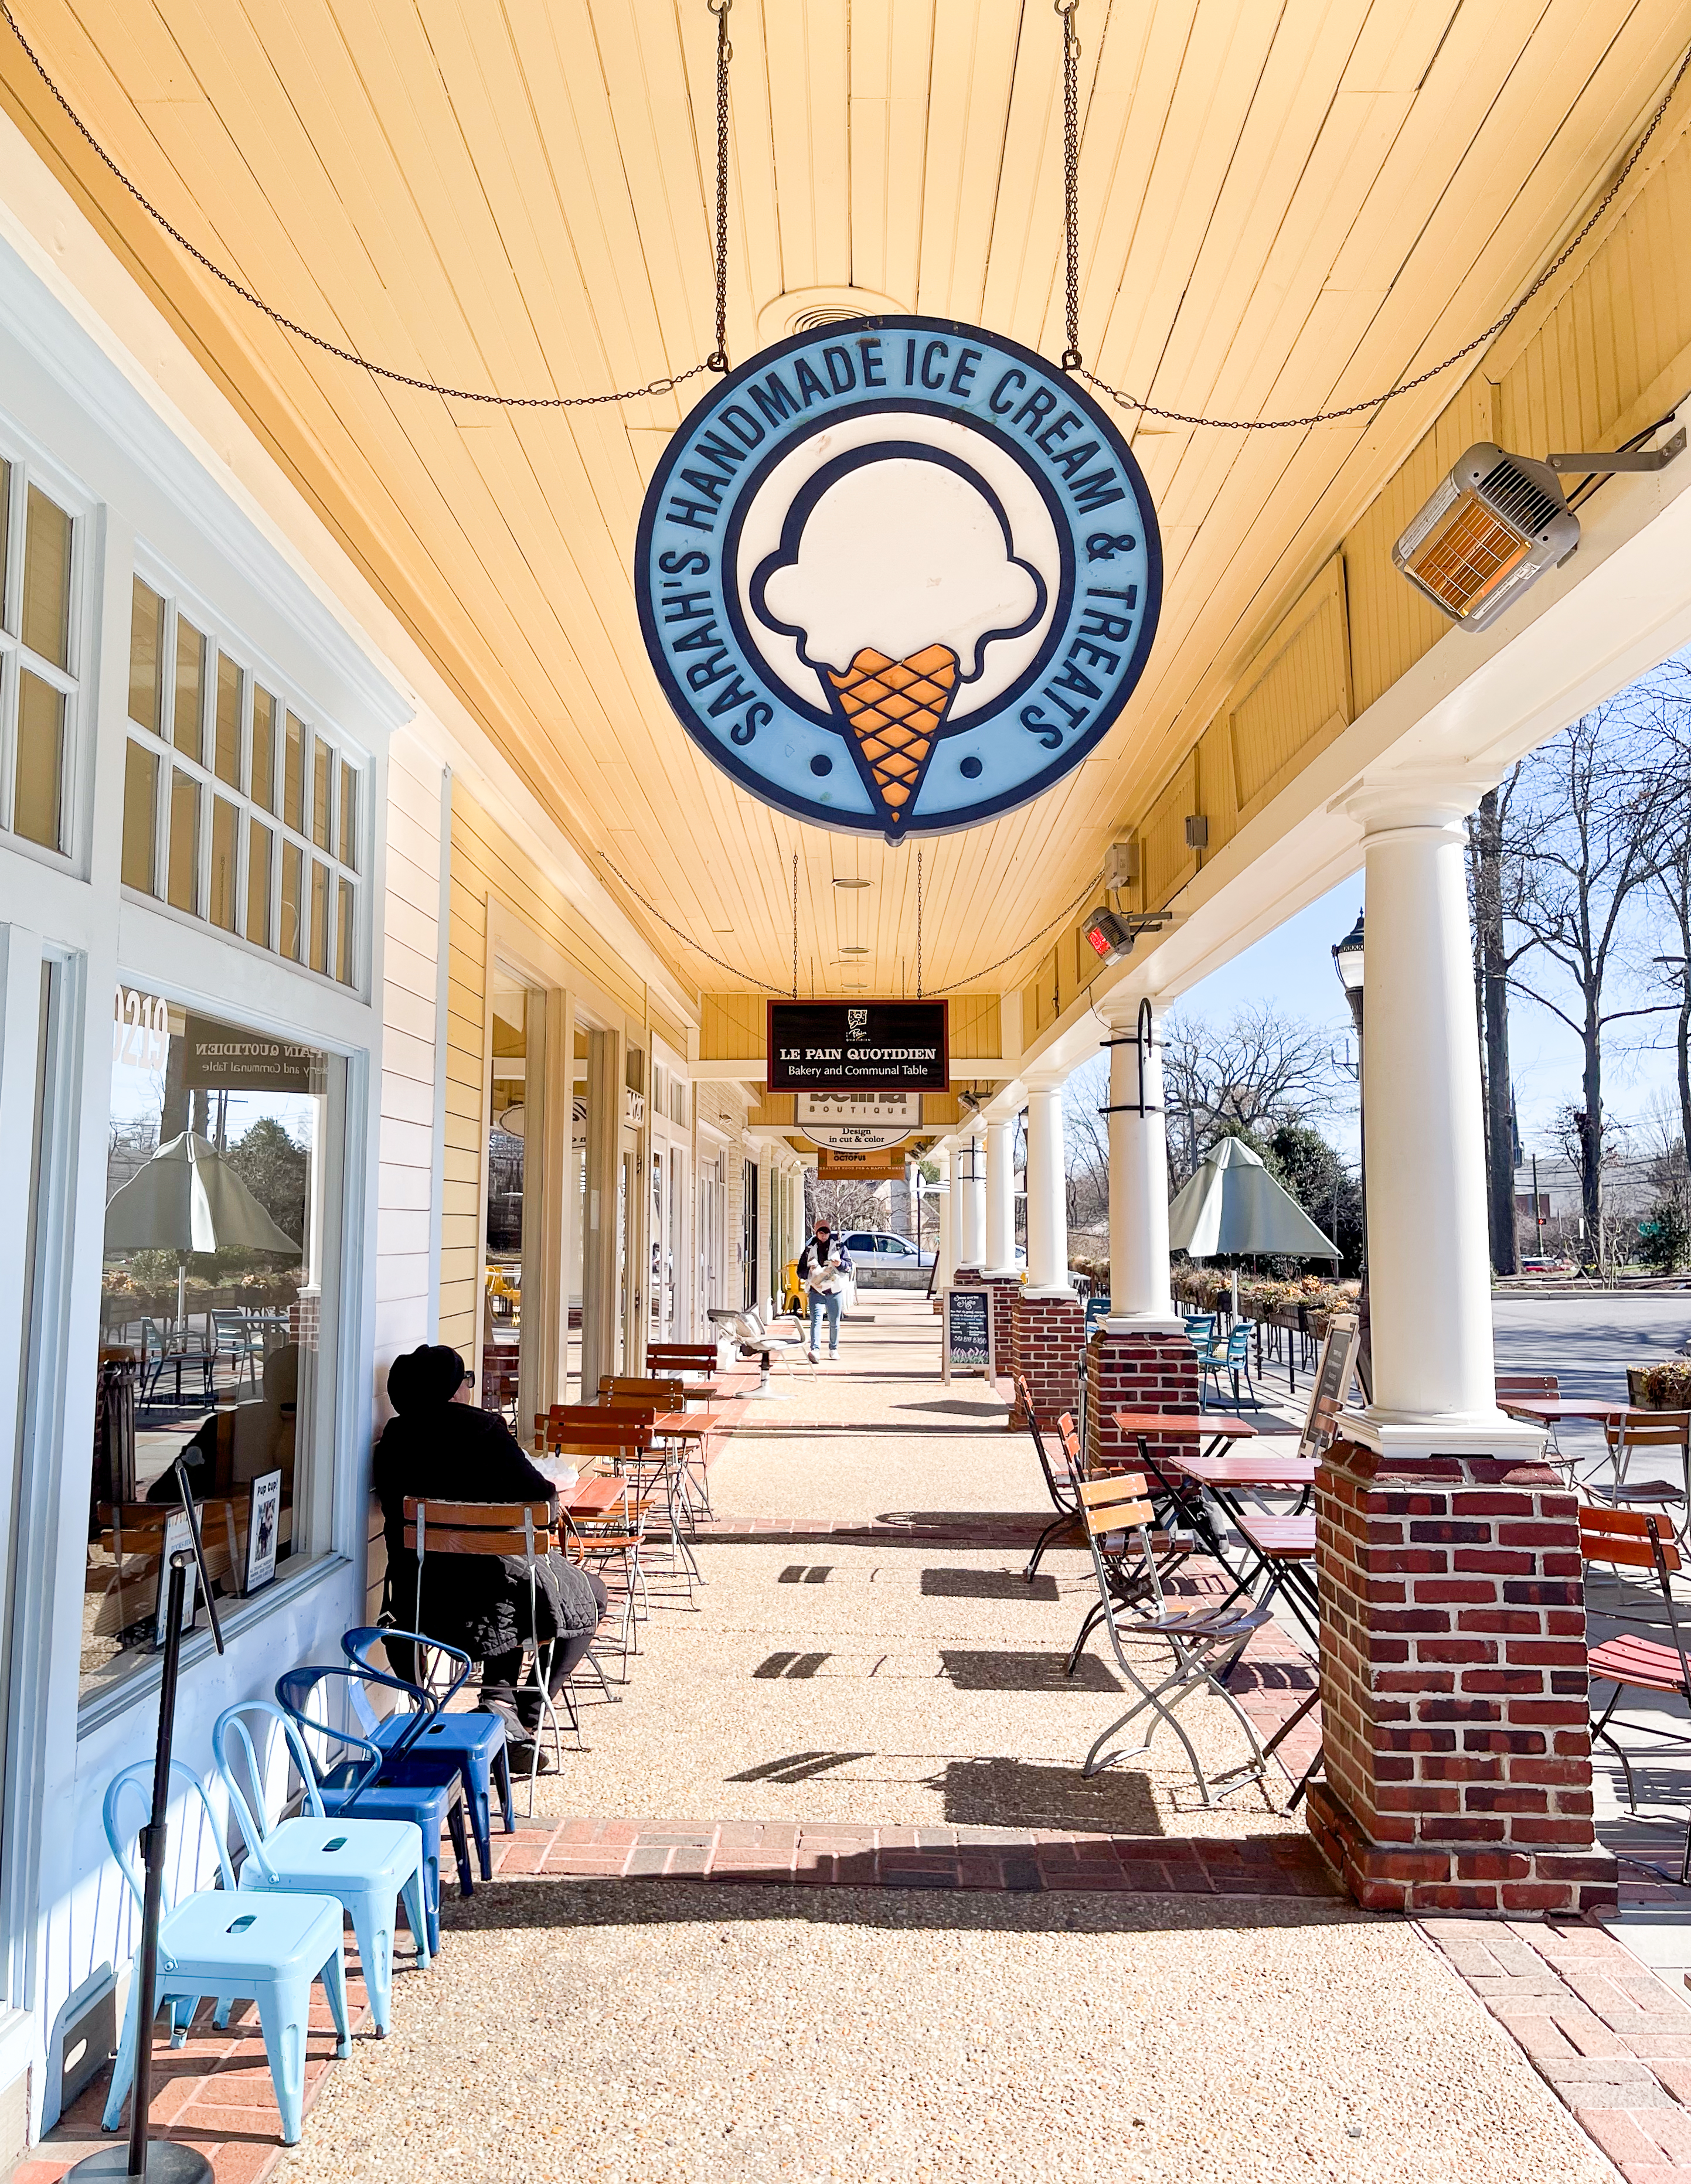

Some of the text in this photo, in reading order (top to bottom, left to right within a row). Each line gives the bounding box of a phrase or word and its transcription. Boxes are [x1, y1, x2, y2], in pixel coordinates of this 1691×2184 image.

[658, 338, 1138, 751] SARAH'S HANDMADE ICE CREAM & TREATS
[780, 1048, 937, 1060] LE PAIN QUOTIDIEN
[788, 1065, 928, 1078] Bakery and Communal Table
[809, 1106, 907, 1114] BOUTIQUE
[842, 1128, 871, 1137] Design
